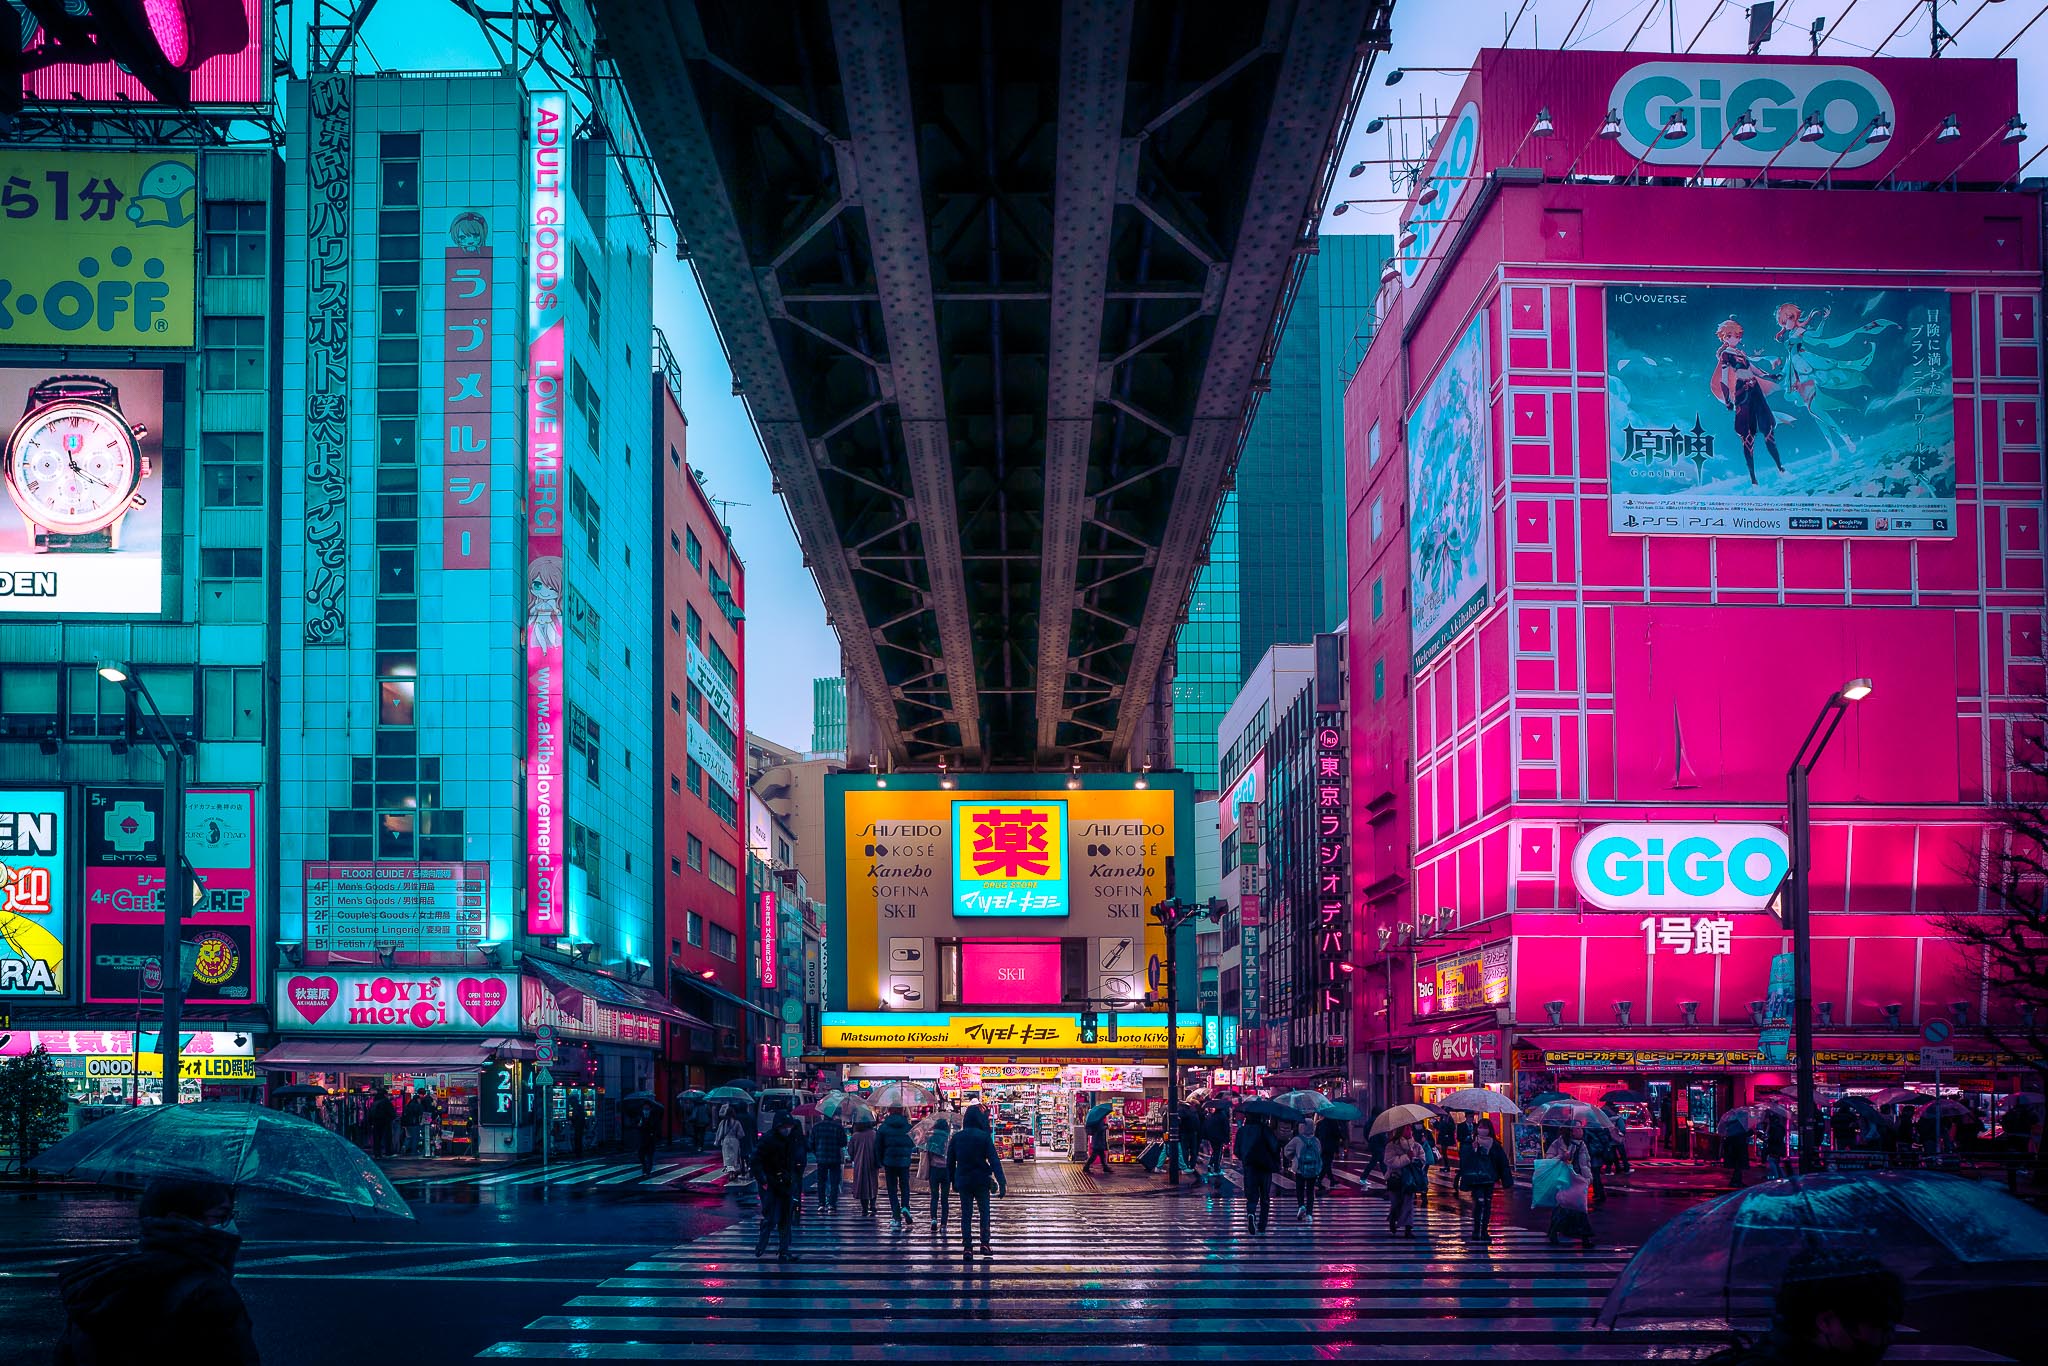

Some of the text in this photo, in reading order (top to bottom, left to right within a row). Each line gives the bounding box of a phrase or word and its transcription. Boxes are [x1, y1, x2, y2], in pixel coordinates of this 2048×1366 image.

[1622, 75, 1881, 153] GiGO
[1, 170, 124, 221] ら1分
[535, 107, 559, 311] ADULT GOODS
[1615, 292, 1688, 304] HOYOVERSE
[1926, 309, 1941, 396] 冒険に満ちた
[1910, 324, 1931, 482] ブランニューワールドへ
[447, 268, 488, 556] ラブメルシー
[533, 360, 559, 535] LOVE MERCI
[1621, 411, 1716, 486] 原神
[1630, 469, 1686, 478] Genshin
[1642, 516, 1781, 529] PS5 PS4 Windows
[1415, 639, 1440, 669] Welcome
[1449, 595, 1485, 636] Akihabara
[697, 664, 731, 723] エンタス
[91, 793, 107, 806] 5F
[532, 666, 551, 922] www.akibalovemerci.com
[855, 824, 942, 837] SHISEIDO
[1077, 823, 1165, 836] SHISEIDO
[892, 843, 935, 857] KOSÉ
[972, 809, 1051, 878] 薬
[1115, 843, 1158, 856] KOSÉ
[102, 854, 158, 862] ENTAS
[341, 869, 373, 878] FLOOR
[375, 869, 405, 878] GUIDE
[866, 864, 933, 878] Kanebo
[1089, 863, 1156, 878] Kanebo
[1586, 836, 1789, 897] GiGO
[4, 867, 50, 912] 迎
[313, 881, 329, 892] 4F
[337, 882, 363, 891] Men's
[365, 882, 395, 891] Goods
[1319, 756, 1342, 1011] 東京ラジオデパート
[91, 889, 111, 904] 4F
[871, 885, 929, 898] SOFINA
[1094, 885, 1153, 898] SOFINA
[313, 895, 329, 906] 3F
[337, 896, 363, 905] Men's
[365, 896, 395, 905] Goods
[960, 890, 1062, 914] マツモトキヨシ
[314, 909, 329, 921] 2F
[337, 910, 377, 921] Couple's
[379, 911, 410, 920] Goods
[883, 904, 917, 919] SK-II
[315, 924, 329, 935] 1F
[337, 925, 379, 934] Costume
[381, 925, 419, 936] Lingerie
[1640, 917, 1734, 955] 1号館
[315, 938, 329, 949] B1
[337, 939, 366, 949] Fetish
[763, 972, 773, 984] 2
[808, 961, 816, 996] mouse
[997, 967, 1025, 981] SK-II
[1244, 926, 1257, 1020] ホビーステーション
[295, 987, 331, 1000] 秋葉原
[354, 977, 437, 1004] LOVE
[1417, 982, 1434, 998] BIG
[840, 1032, 949, 1042] Matsumoto KiYoshi
[964, 1023, 1060, 1045] マツモトキヨシ
[1143, 1033, 1186, 1042] KiYohi
[1207, 1021, 1217, 1049] GiGO
[1084, 1076, 1101, 1084] Free
